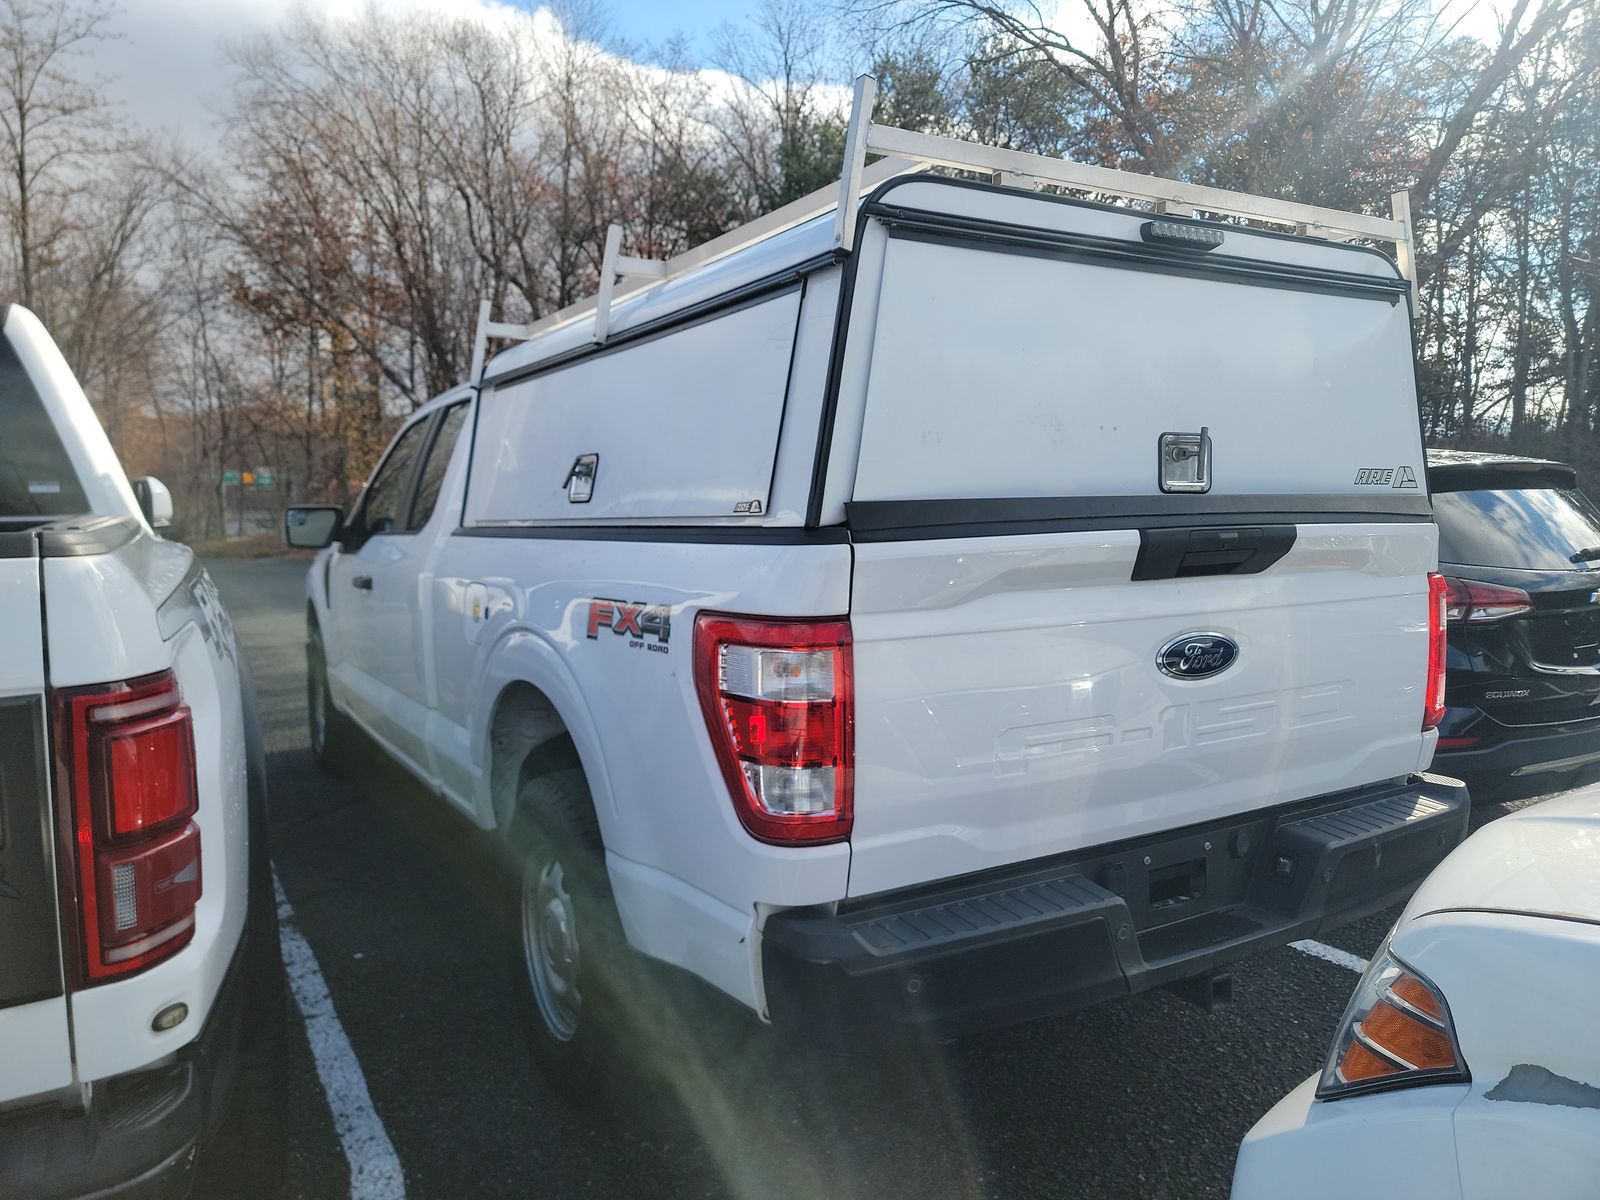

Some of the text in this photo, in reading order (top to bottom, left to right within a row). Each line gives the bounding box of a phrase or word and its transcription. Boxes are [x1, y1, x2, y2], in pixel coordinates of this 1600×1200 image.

[1354, 468, 1394, 485] ARE
[587, 597, 671, 643] FX4
[629, 640, 669, 654] OFF ROAD
[1180, 643, 1224, 670] Ford
